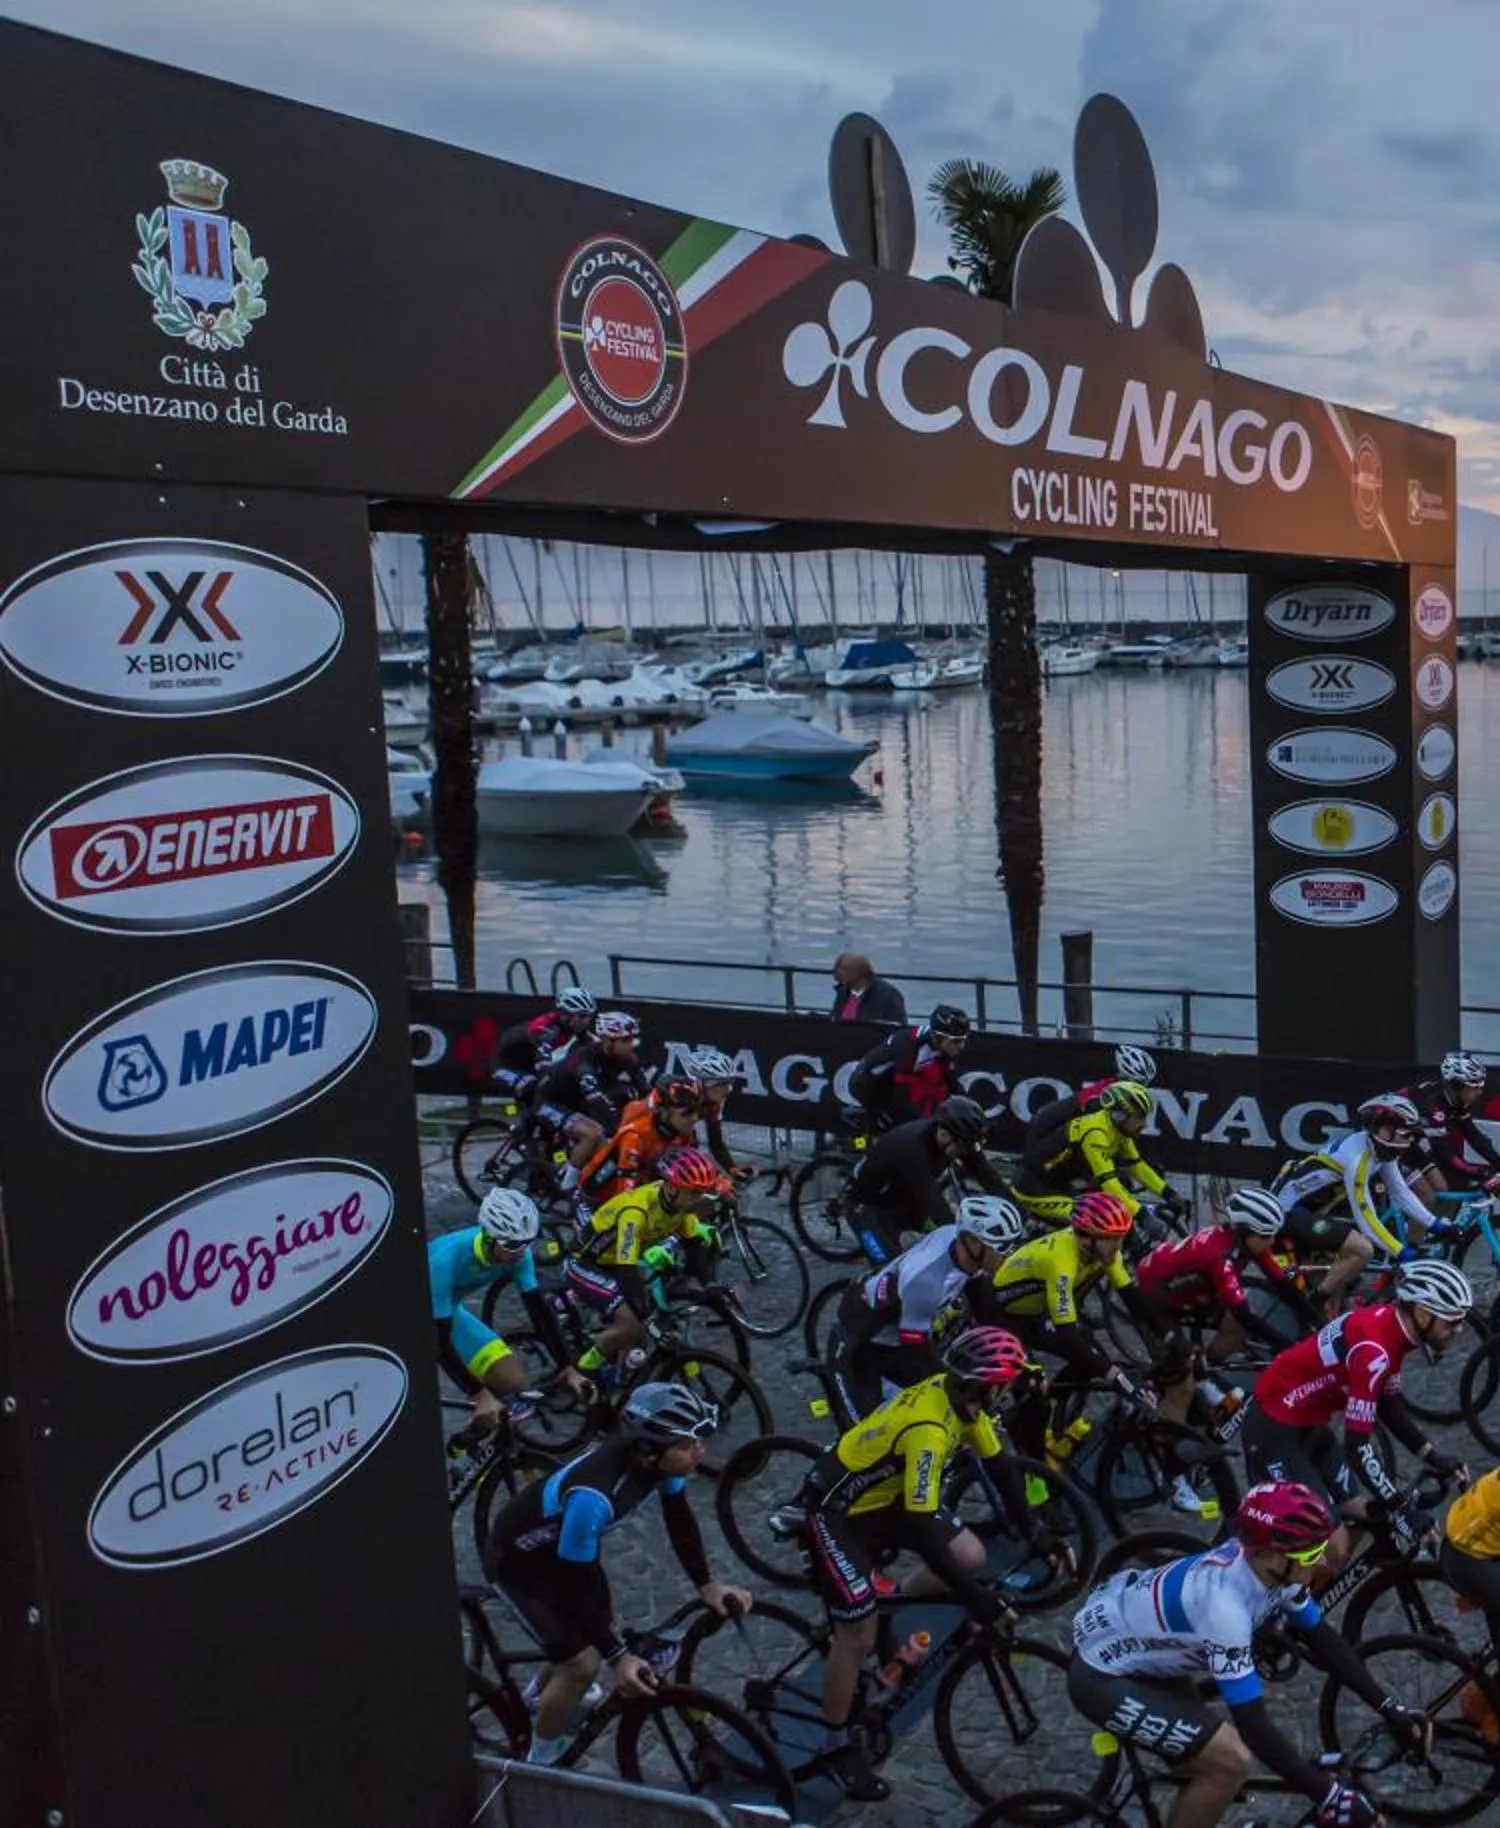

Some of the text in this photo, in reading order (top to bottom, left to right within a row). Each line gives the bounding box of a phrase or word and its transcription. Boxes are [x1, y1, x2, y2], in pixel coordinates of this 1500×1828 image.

[571, 252, 672, 317] COLNAGO
[605, 319, 655, 343] CYCLING
[607, 338, 660, 363] FESTIVAL
[58, 377, 349, 435] Desenzano del Garda
[159, 355, 262, 393] Città di
[876, 327, 1312, 492] COLNAGO
[1011, 468, 1219, 538] CYCLING FESTIVAL
[1280, 598, 1373, 628] Dryarn
[146, 804, 319, 876] ENERVIT
[179, 997, 328, 1087] MAPEI
[97, 1191, 365, 1306] noleggiare
[128, 1390, 357, 1522] dorelan
